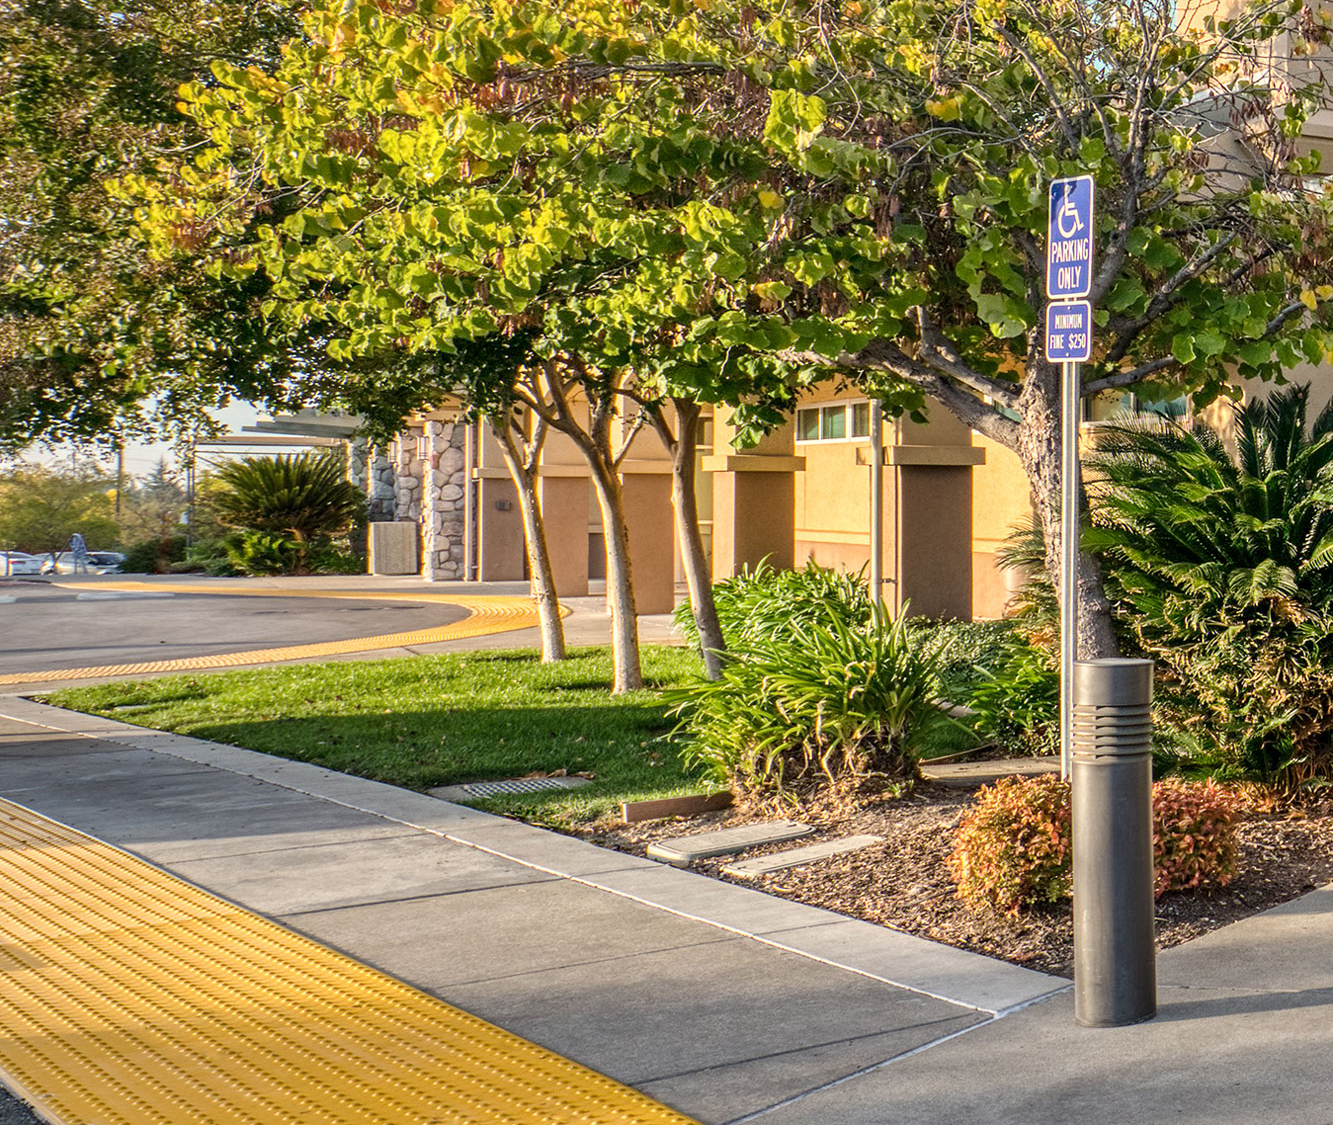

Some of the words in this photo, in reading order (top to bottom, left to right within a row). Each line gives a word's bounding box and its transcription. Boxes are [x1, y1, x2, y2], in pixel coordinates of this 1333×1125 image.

[1051, 238, 1088, 263] PARKING
[1057, 265, 1081, 289] ONLY
[1054, 313, 1082, 329] MINIMUM
[1049, 334, 1065, 349] FINE
[1068, 333, 1087, 350] $250
